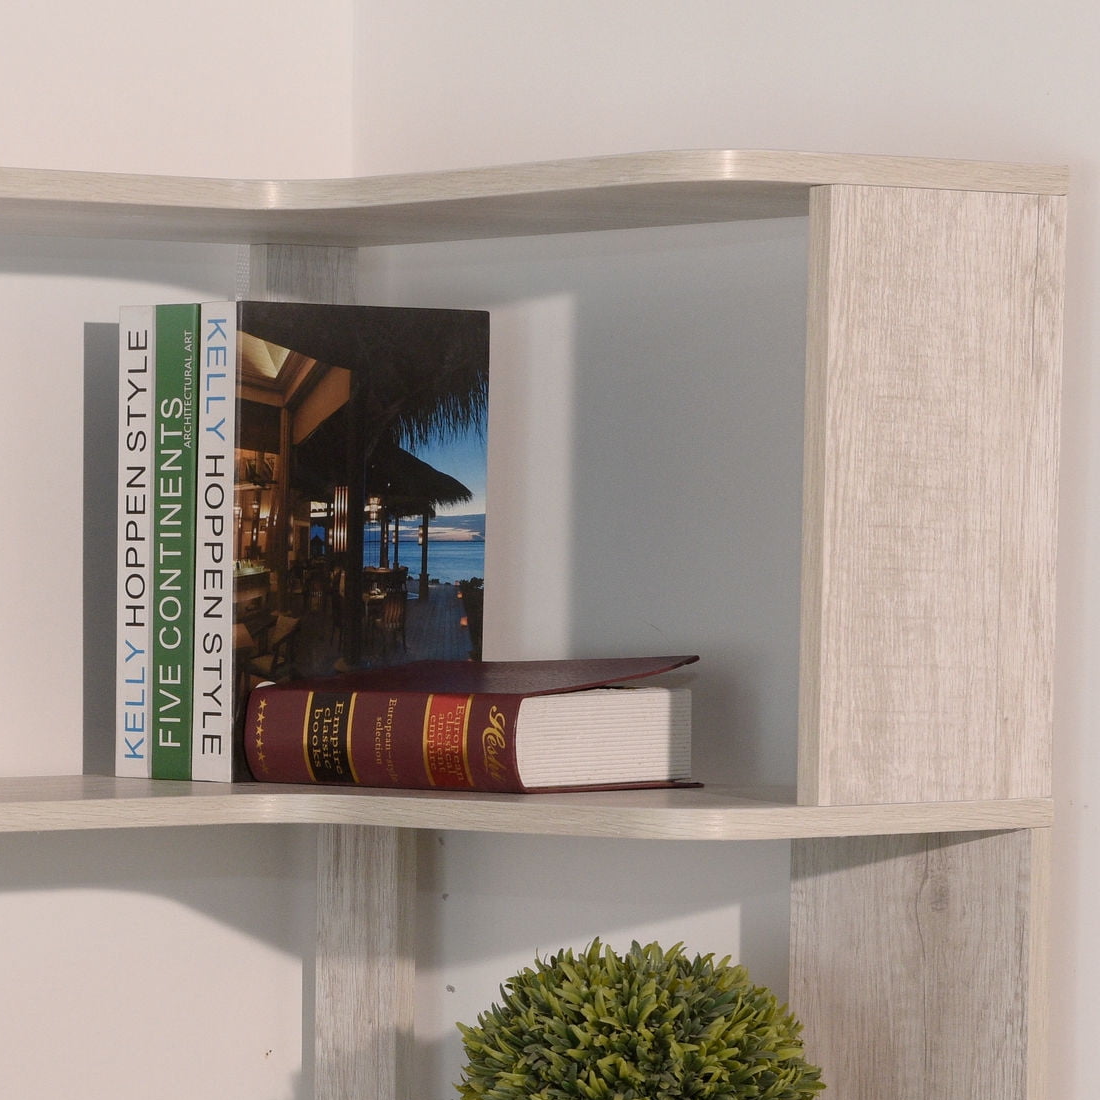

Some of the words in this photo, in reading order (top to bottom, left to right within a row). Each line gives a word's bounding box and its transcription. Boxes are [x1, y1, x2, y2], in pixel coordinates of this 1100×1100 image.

[184, 329, 193, 352] ART
[205, 318, 227, 441] KELLY
[126, 329, 148, 452] STYLE
[183, 355, 192, 449] ARCHITECTURAL
[125, 466, 146, 627] HOPPEN
[158, 397, 183, 650] CONTINENTS
[203, 455, 225, 618] HOPPEN
[124, 639, 145, 759] KELLY
[158, 664, 181, 747] FIVE
[202, 632, 223, 755] STYLE
[312, 707, 324, 767] books
[322, 707, 332, 769] classic
[330, 700, 345, 774] Empire
[375, 717, 384, 765] selection
[428, 714, 437, 770] empire
[436, 713, 446, 773] ancient
[445, 711, 455, 774] classical
[451, 704, 466, 781] European
